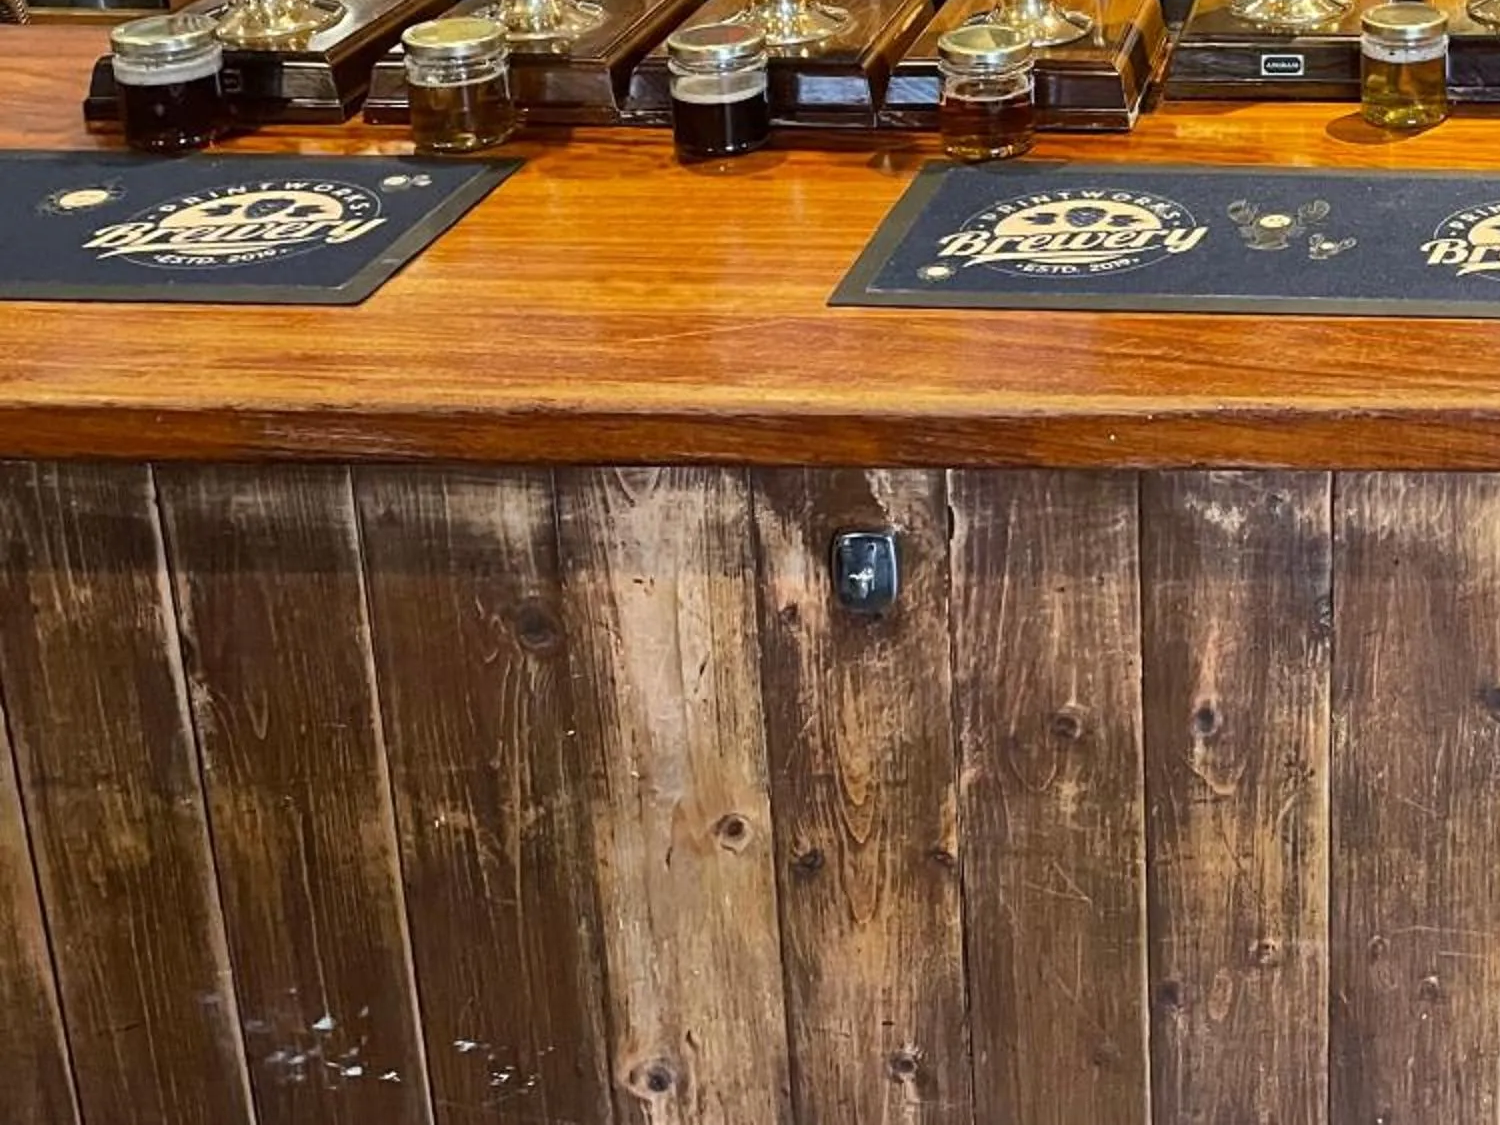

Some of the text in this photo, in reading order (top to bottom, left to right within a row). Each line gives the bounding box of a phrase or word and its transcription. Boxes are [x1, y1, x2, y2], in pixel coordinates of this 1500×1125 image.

[160, 180, 371, 216] PRINTWORKS
[982, 190, 1181, 223] PRINTWORKS
[83, 216, 388, 258] Brewery
[938, 224, 1208, 261] Brewery
[1089, 258, 1132, 272] 2019
